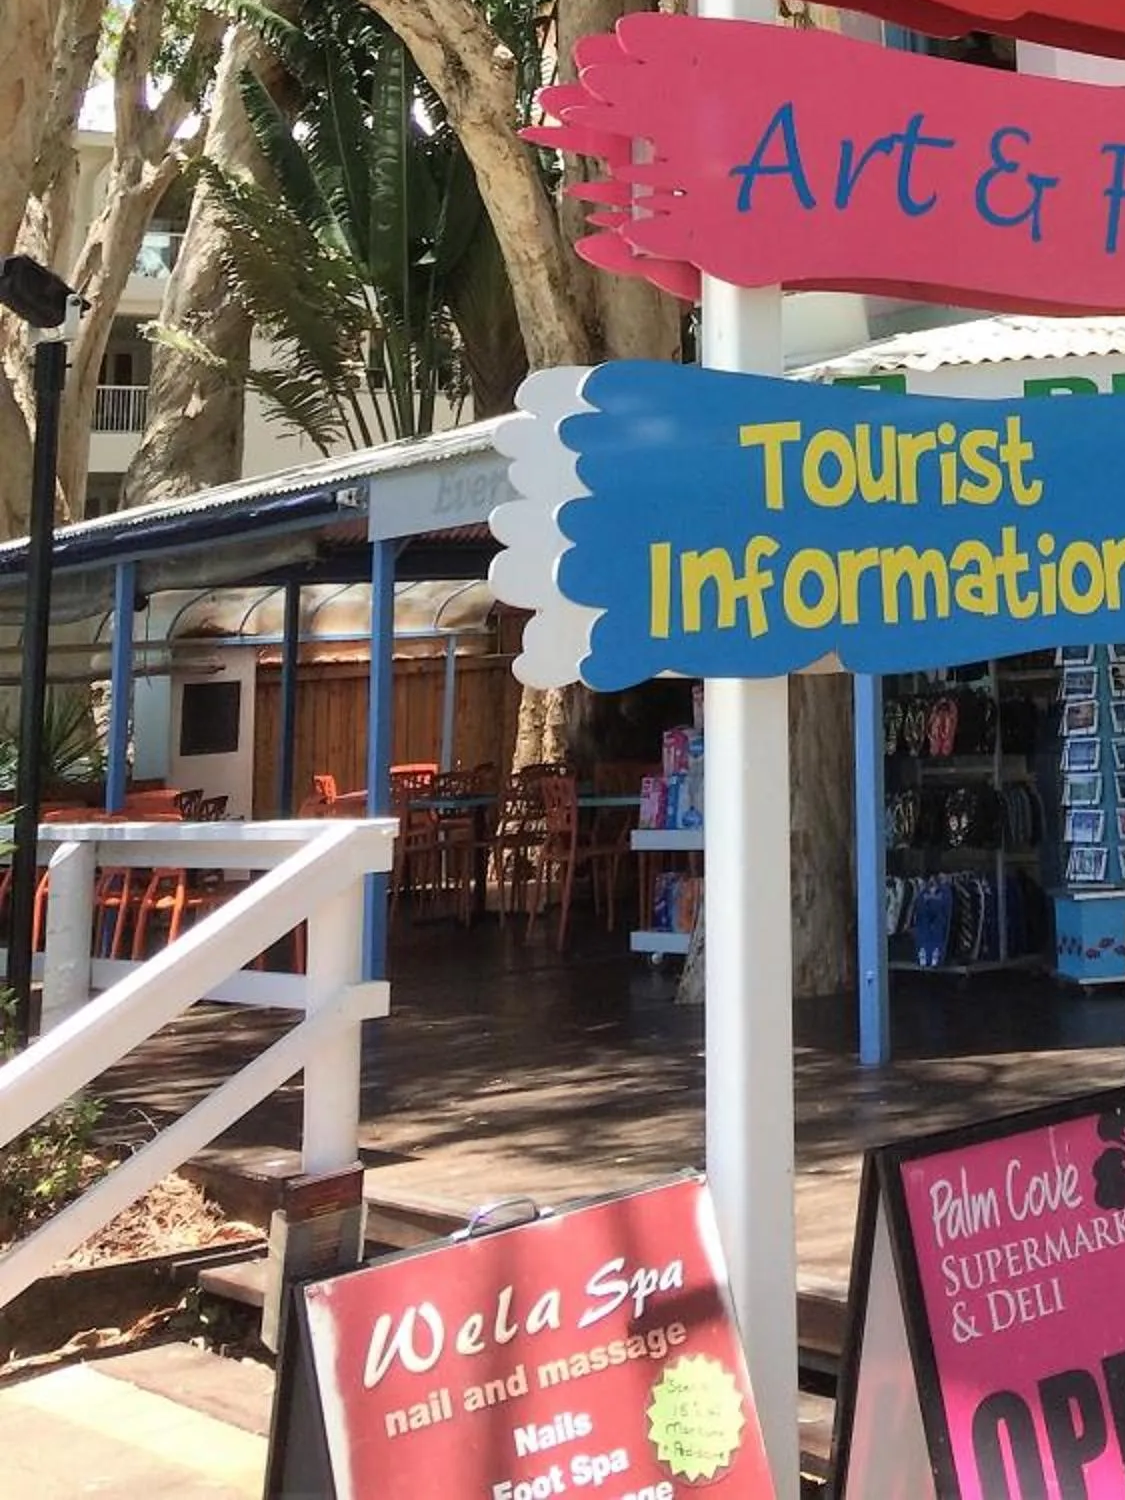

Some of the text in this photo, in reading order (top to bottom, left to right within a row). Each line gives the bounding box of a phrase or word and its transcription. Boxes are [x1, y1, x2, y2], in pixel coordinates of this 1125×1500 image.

[729, 100, 955, 216] Art
[975, 125, 1058, 243] &
[738, 414, 1043, 510] Tourist
[929, 1140, 1083, 1249] Palm Cove
[362, 1256, 684, 1390] Wela Spa
[950, 1277, 1067, 1345] & DELI
[384, 1320, 688, 1439] nail and massage
[492, 1464, 566, 1500] Foot
[570, 1448, 630, 1485] Spa
[513, 1411, 594, 1457] Nails
